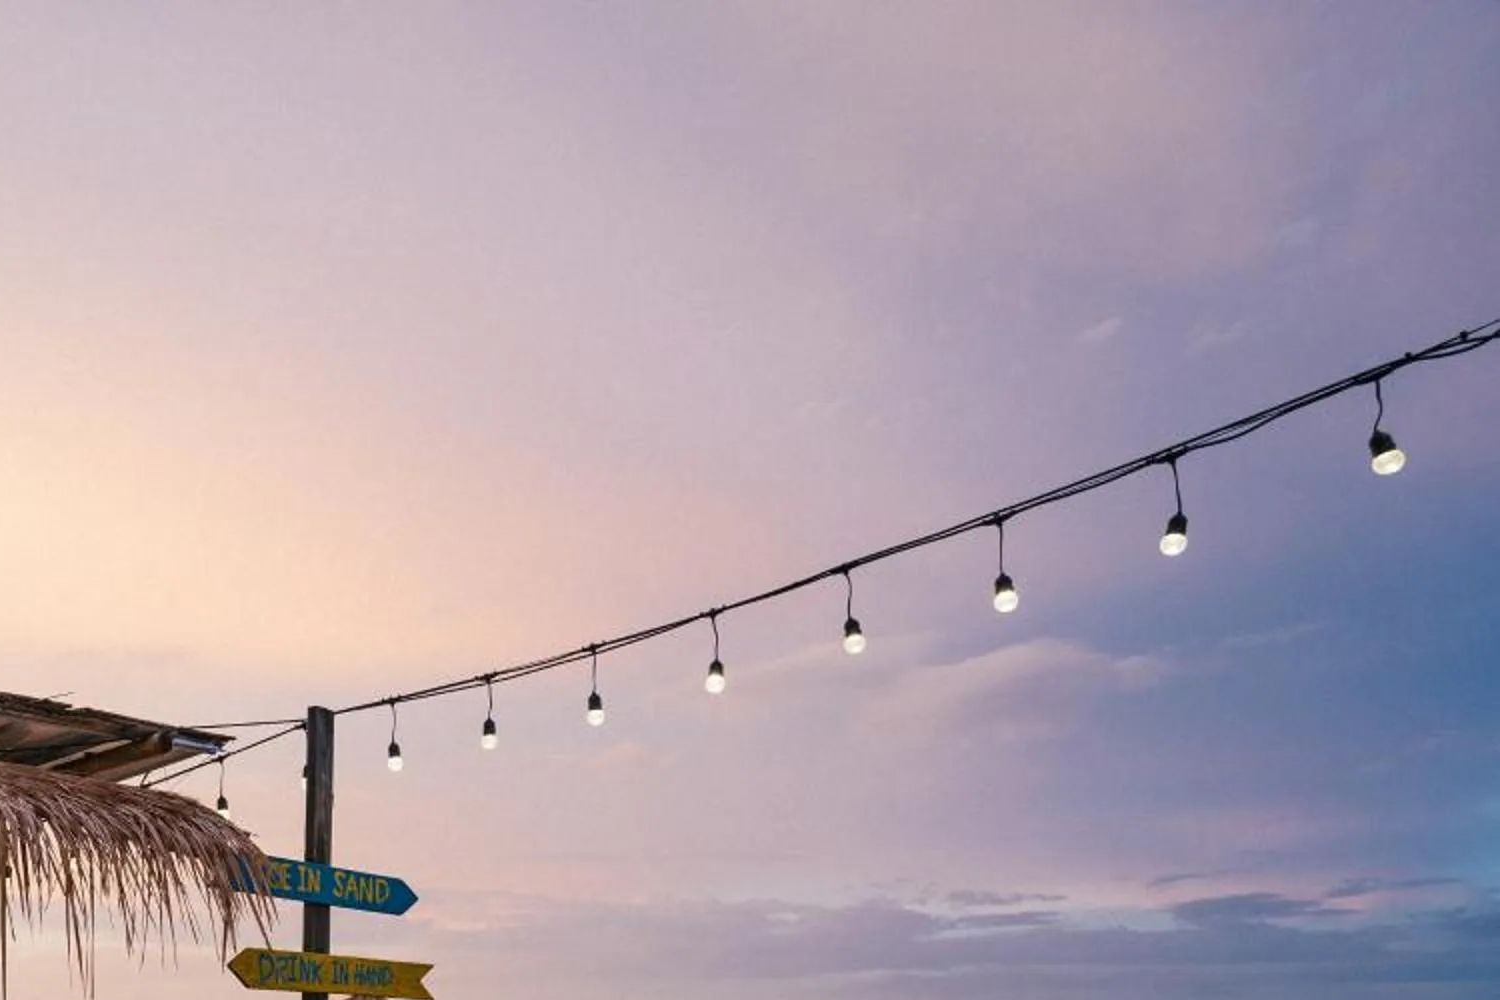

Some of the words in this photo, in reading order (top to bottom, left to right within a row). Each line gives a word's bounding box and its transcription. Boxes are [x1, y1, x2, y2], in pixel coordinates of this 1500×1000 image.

[297, 864, 321, 894] IN
[333, 870, 390, 905] SAND
[258, 952, 323, 985] DRINK
[333, 959, 349, 986] IN
